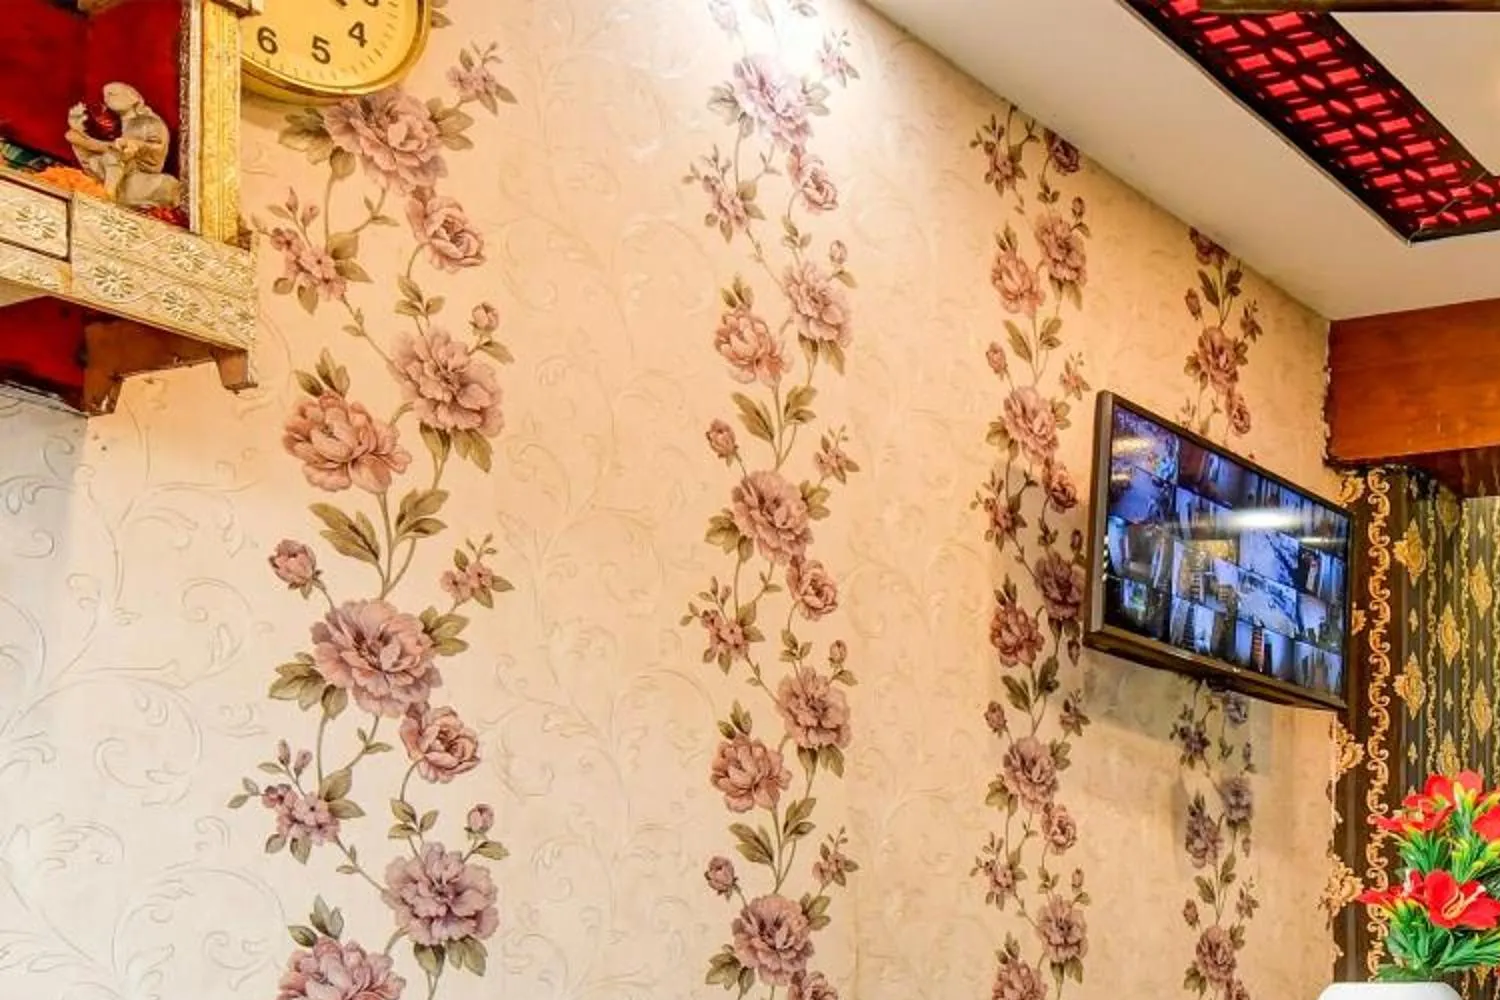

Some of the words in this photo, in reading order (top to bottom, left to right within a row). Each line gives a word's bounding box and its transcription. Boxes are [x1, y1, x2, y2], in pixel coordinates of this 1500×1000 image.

[256, 26, 278, 55] 6
[347, 21, 367, 48] 4
[311, 35, 331, 65] 5
